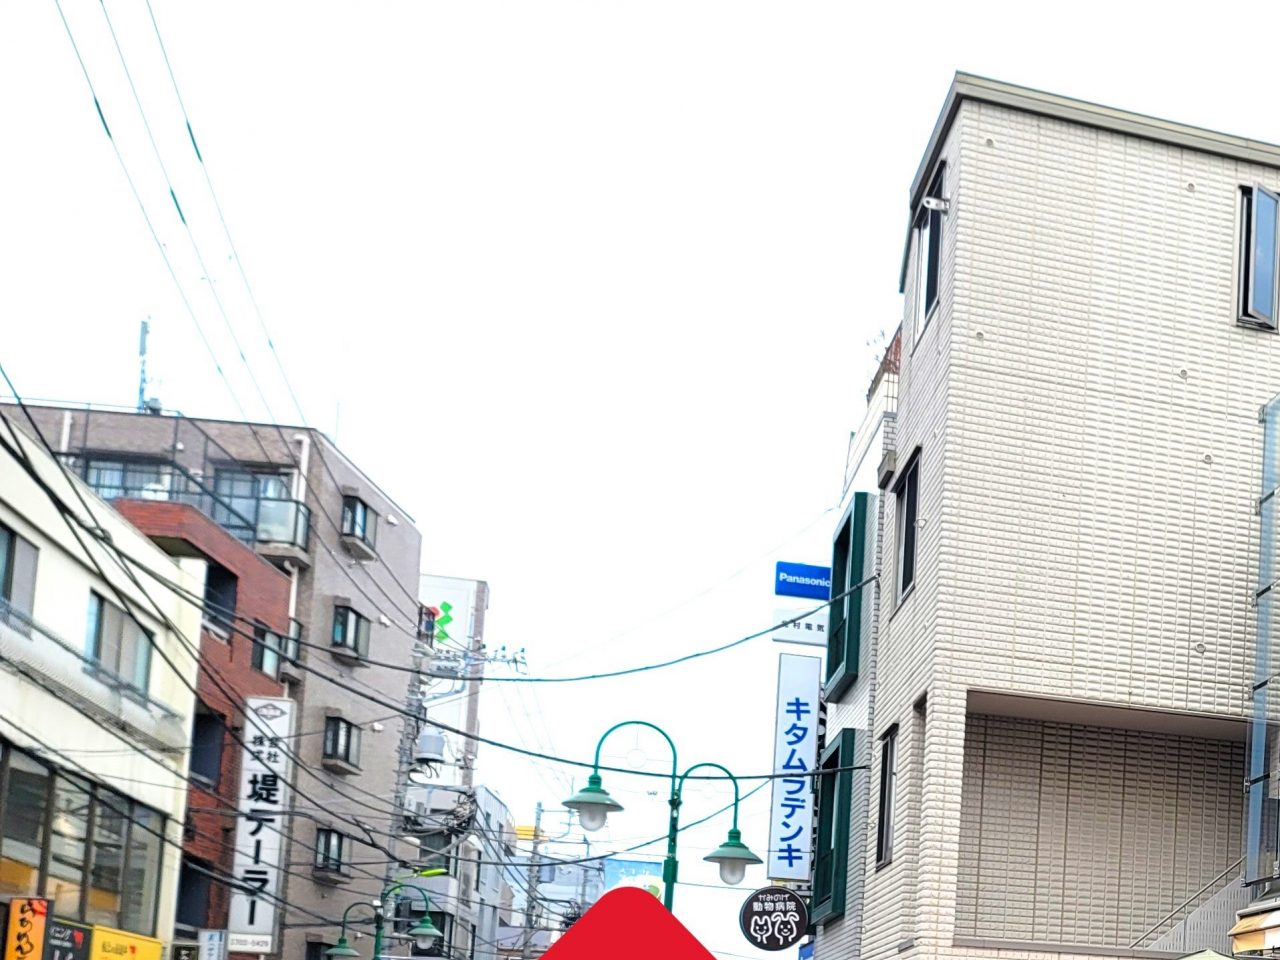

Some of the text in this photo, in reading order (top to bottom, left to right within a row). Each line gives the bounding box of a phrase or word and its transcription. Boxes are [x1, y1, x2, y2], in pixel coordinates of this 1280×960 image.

[779, 572, 831, 588] Panasonic
[777, 697, 811, 867] キタムラデンキ
[243, 774, 279, 926] 堤テーラー
[752, 901, 797, 912] 動物病院
